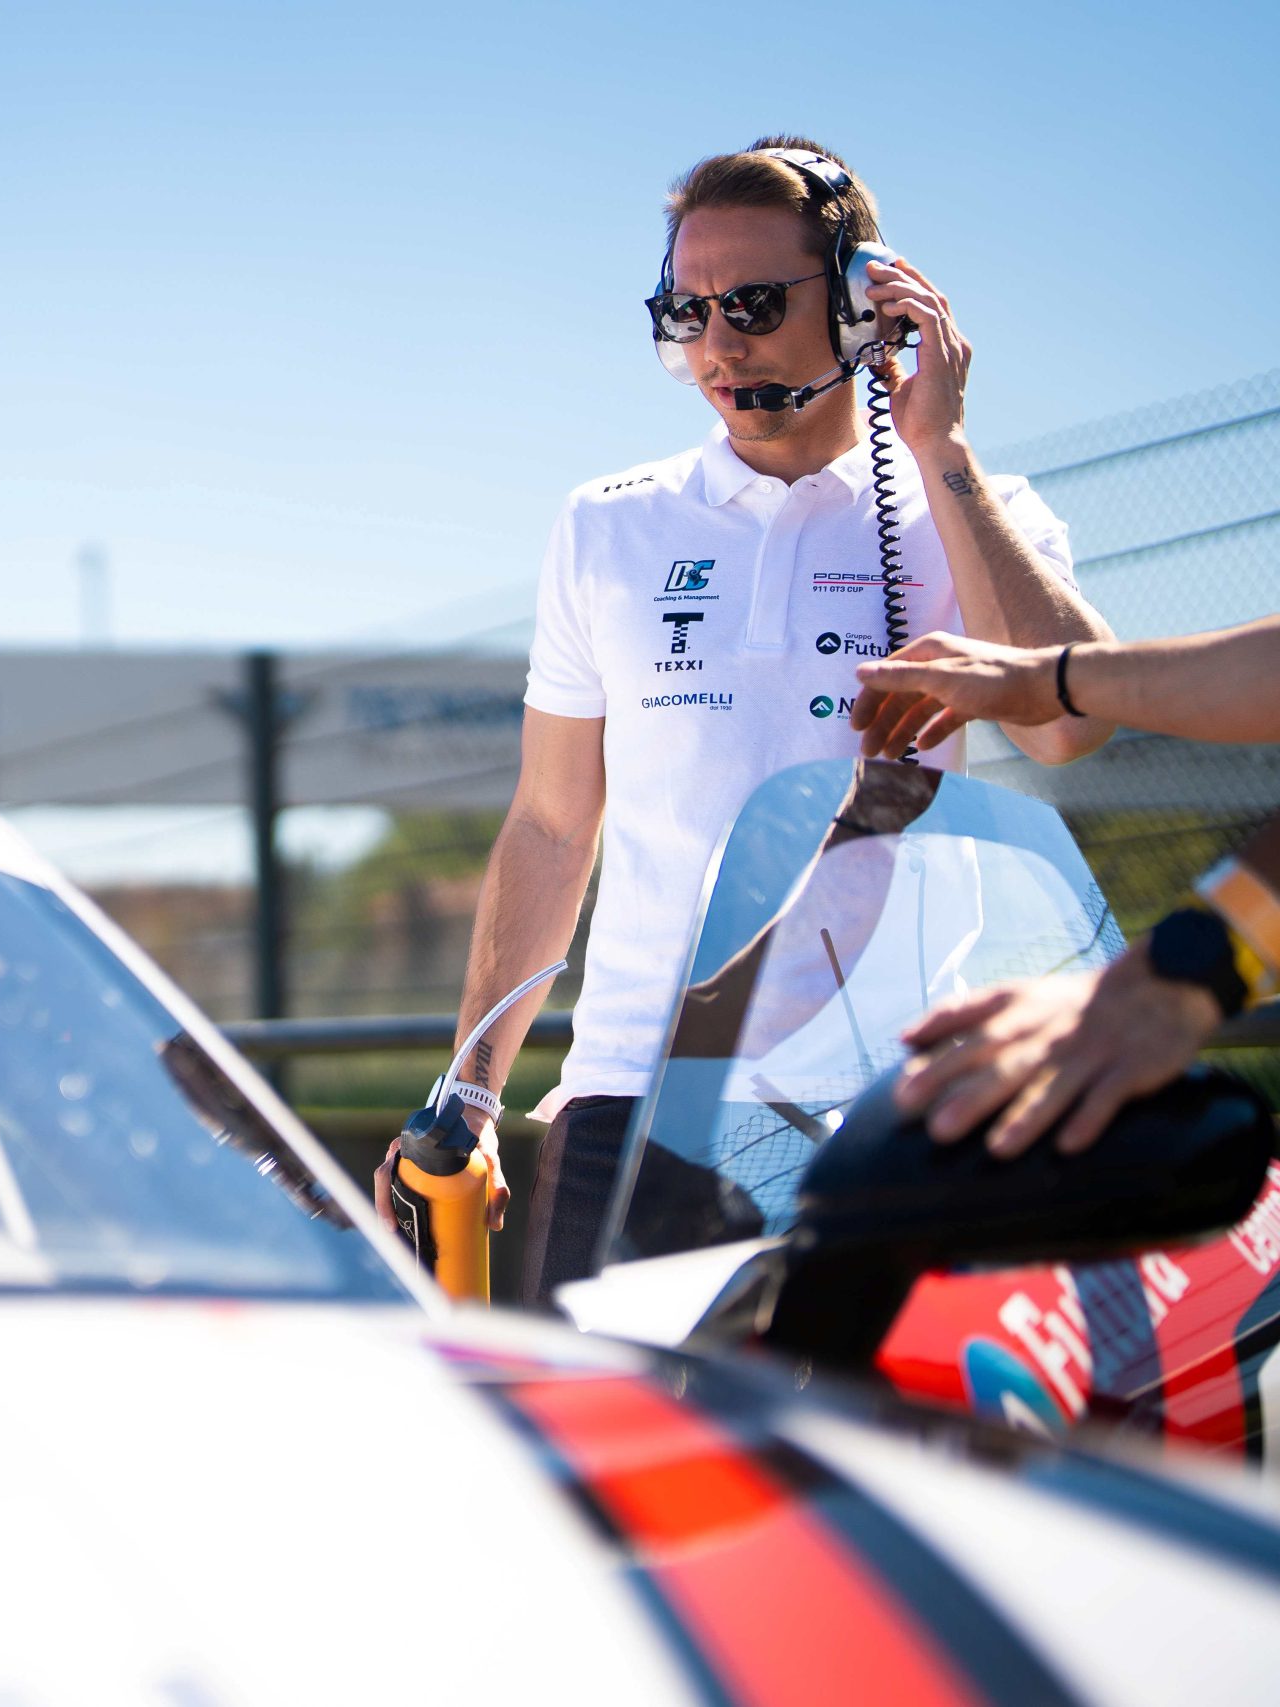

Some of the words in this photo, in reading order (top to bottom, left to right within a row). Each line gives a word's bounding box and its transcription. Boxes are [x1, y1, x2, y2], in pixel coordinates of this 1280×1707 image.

[813, 572, 913, 582] PORSCE
[812, 585, 828, 593] 911
[829, 585, 846, 593] GT3
[845, 632, 873, 640] Gruppo
[844, 639, 889, 658] Futu
[654, 659, 703, 673] TEXXI
[641, 692, 733, 710] GIACOMELLI
